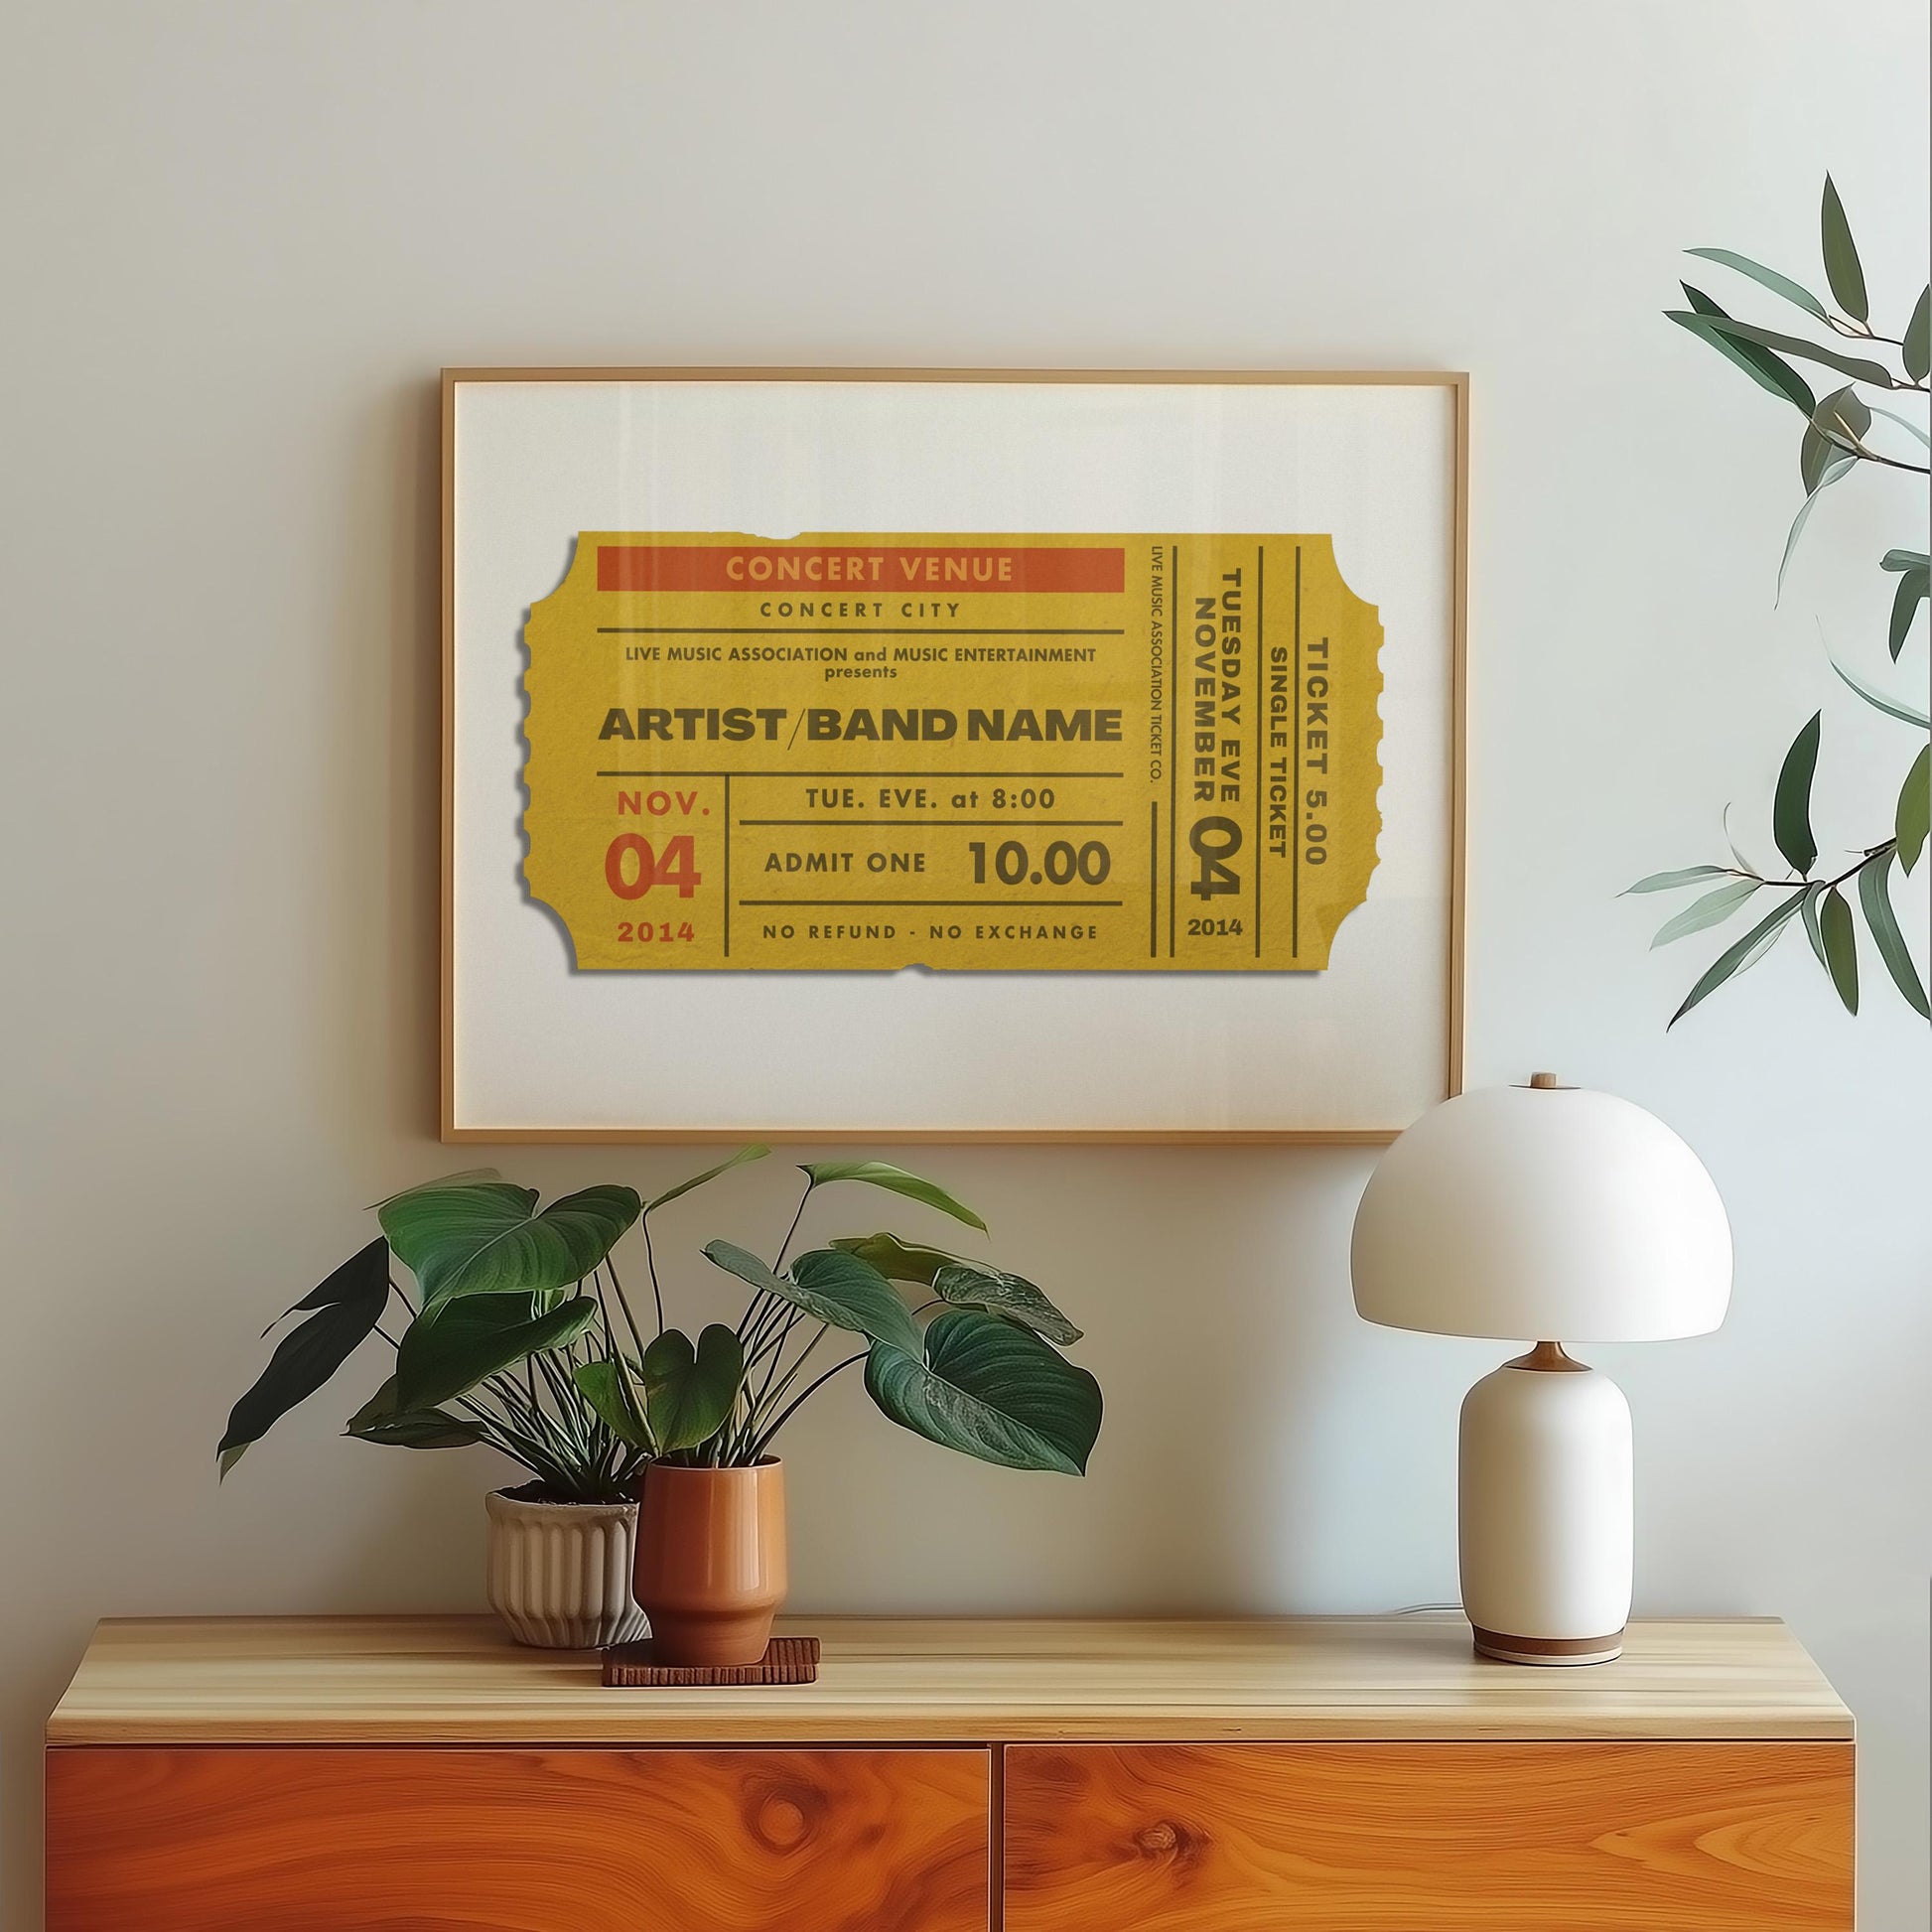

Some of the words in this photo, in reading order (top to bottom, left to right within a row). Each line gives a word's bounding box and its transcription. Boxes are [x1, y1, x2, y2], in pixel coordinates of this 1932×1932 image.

[727, 556, 884, 581] CONCERT
[899, 557, 1012, 581] VENUE
[1152, 546, 1163, 571] LIVE
[760, 603, 882, 617] CONCERT
[901, 603, 959, 618] CITY
[1152, 576, 1163, 617] MUSIC
[626, 647, 660, 660] LIVE
[667, 647, 721, 660] MUSIC
[729, 647, 847, 661] ASSOCIATION
[854, 647, 886, 661] and
[894, 648, 947, 661] MUSIC
[955, 648, 1096, 661] ENTERTAINMENT
[1222, 568, 1241, 725] TUESDAY
[825, 666, 897, 682] presents
[1151, 621, 1163, 710] ASSOCIATION
[1194, 598, 1216, 801] NOVEMBER
[1271, 647, 1287, 748] SINGLE
[1307, 637, 1328, 774] TICKET
[968, 709, 1122, 741] NAME
[1151, 715, 1162, 758] TICKET
[1149, 759, 1163, 783] CO.
[1221, 740, 1240, 802] EVE
[619, 790, 710, 816] NOV.
[806, 789, 864, 808] TUE.
[880, 789, 936, 808] EVE.
[952, 791, 978, 808] at
[993, 788, 1054, 809] 8:00
[1270, 758, 1287, 858] TICKET
[1306, 790, 1327, 865] 5.00
[605, 833, 701, 900] 04
[764, 853, 853, 872] ADMIT
[867, 853, 924, 873] ONE
[969, 841, 1110, 886] 10.00
[1189, 816, 1242, 900] 04
[618, 922, 694, 942] 2014
[763, 925, 794, 938] NO
[809, 925, 896, 938] REFUND
[930, 925, 961, 939] NO
[976, 925, 1096, 939] EXCHANGE
[1188, 919, 1243, 935] 2014
